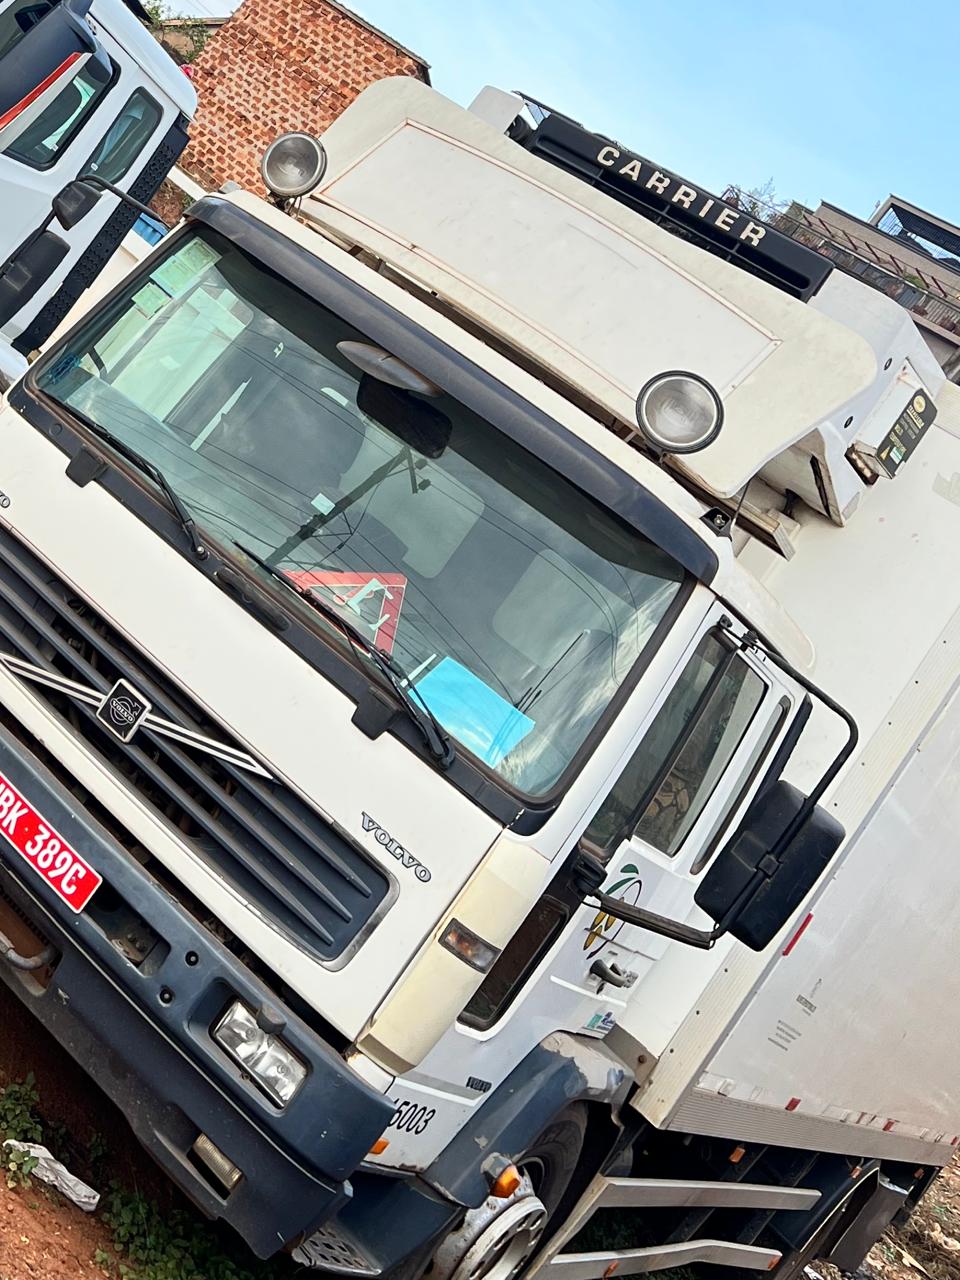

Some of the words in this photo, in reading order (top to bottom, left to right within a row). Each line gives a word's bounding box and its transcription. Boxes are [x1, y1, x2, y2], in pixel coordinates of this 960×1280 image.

[596, 145, 767, 247] CARRIER
[112, 700, 134, 722] VOLVO
[25, 823, 87, 896] 389C
[361, 810, 432, 883] VOLVO
[387, 1098, 436, 1135] 5003
